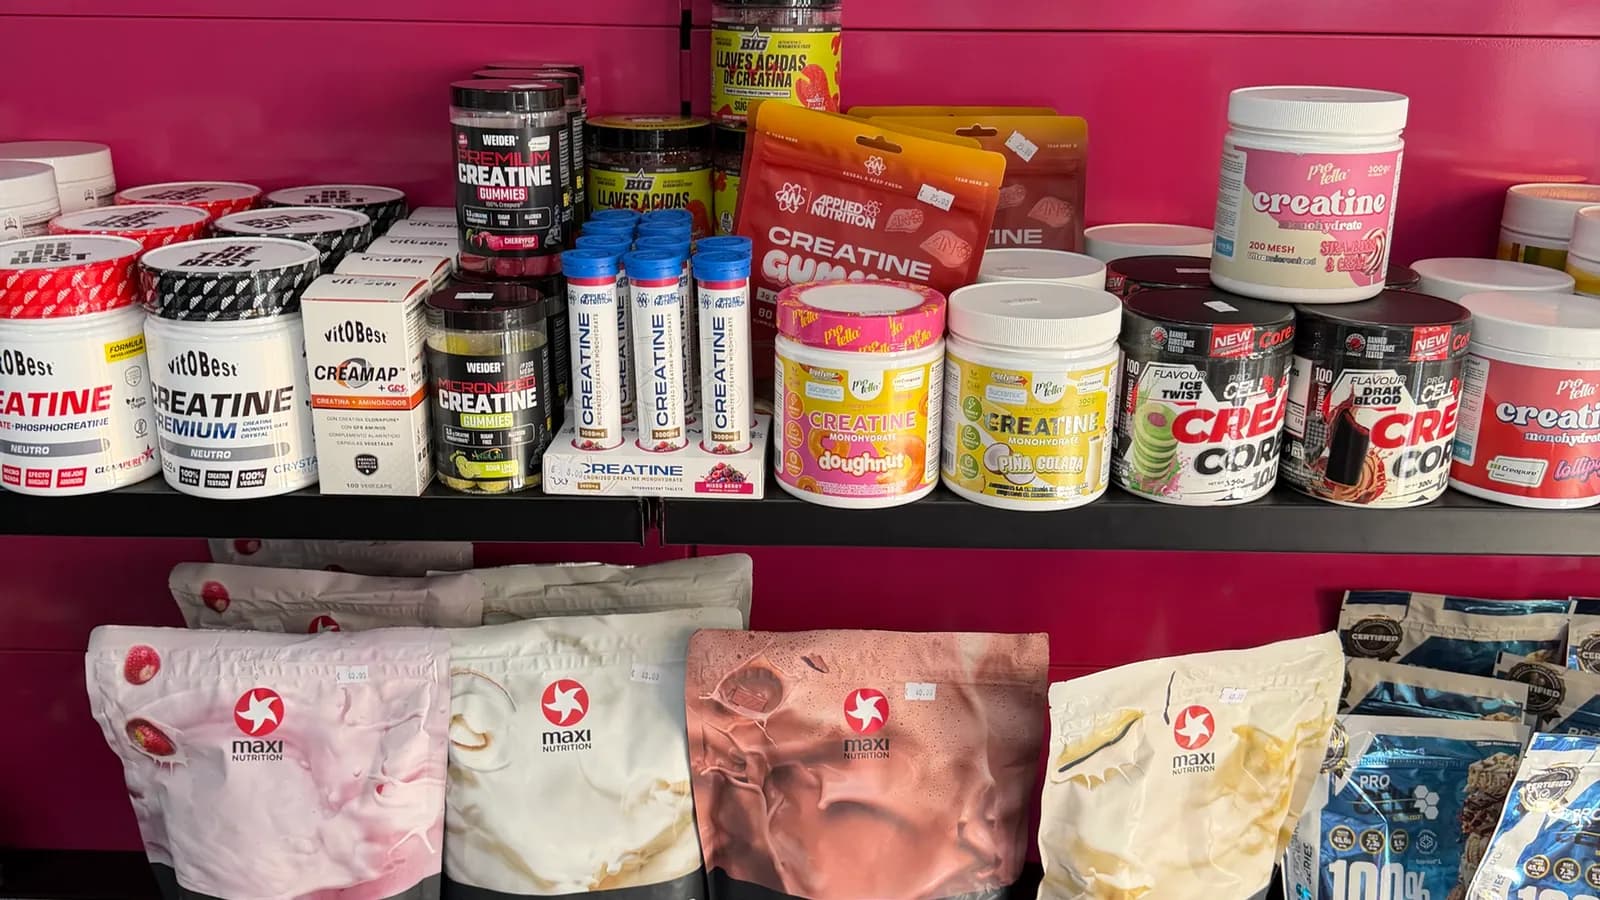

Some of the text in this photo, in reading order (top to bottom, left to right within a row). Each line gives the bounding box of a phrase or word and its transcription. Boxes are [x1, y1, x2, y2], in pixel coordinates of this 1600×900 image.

[740, 38, 768, 50] BIG
[716, 51, 753, 70] LLAVES
[724, 71, 792, 88] DE CREATINA
[482, 134, 516, 146] WEIDER
[458, 150, 550, 166] PREMIUM
[458, 164, 552, 187] CREATINE
[624, 180, 654, 191] BIG
[479, 188, 526, 202] GUMMIES
[598, 189, 639, 209] LLAVES
[1253, 188, 1387, 216] creatine
[813, 194, 863, 216] APPLIED
[811, 206, 876, 229] NUTRITION
[990, 228, 1042, 244] INE
[768, 226, 933, 281] CREATINE
[1249, 241, 1295, 254] 200 MESH
[758, 307, 773, 320] 80
[324, 320, 387, 343] vitOBest
[1214, 329, 1251, 348] NEW
[1366, 344, 1395, 353] SUBSTANCE
[1414, 332, 1448, 351] NEW
[168, 350, 237, 377] vitOBest
[466, 362, 501, 374] WEIDER
[578, 312, 594, 425] CREATINE
[652, 314, 668, 426] CREATINE
[1126, 358, 1140, 375] 100
[314, 365, 398, 382] CREAMAP
[713, 316, 727, 429] CREATINE
[1153, 369, 1206, 381] FLAVOUR
[1315, 367, 1332, 383] 100
[1350, 375, 1407, 385] FLAVOUR
[438, 376, 536, 394] MICRONIZED
[1180, 381, 1203, 391] ICE
[1426, 376, 1444, 386] PRO
[1162, 390, 1203, 400] TWIST
[1363, 386, 1402, 396] DRAK
[151, 381, 294, 418] CREATINE
[316, 397, 351, 406] CREATINA
[438, 387, 538, 413] CREATINE
[1354, 395, 1402, 406] BLOOD
[15, 417, 109, 432] PHOSPHOCREATINE
[463, 414, 512, 428] GUMMIES
[809, 411, 916, 433] CREATINE
[986, 412, 1099, 437] CREATINE
[830, 432, 896, 442] MONOHYDRATE
[1008, 436, 1081, 447] MONOHYDRATE
[10, 444, 50, 455] NEUTRO
[190, 448, 232, 460] NEUTRO
[819, 451, 906, 476] doughnut
[1037, 456, 1084, 473] COLADA
[1502, 465, 1537, 476] Creapure
[180, 467, 199, 478] 100%
[240, 469, 265, 480] 100%
[1351, 632, 1398, 643] CERTIFIED
[543, 729, 591, 745] maxi
[232, 740, 283, 753] maxi
[543, 743, 592, 753] NUTRITION
[844, 738, 890, 752] maxi
[843, 751, 890, 760] NUTRITION
[1172, 752, 1215, 769] maxi
[1172, 766, 1216, 776] NUTRITION
[1360, 774, 1391, 789] PRO
[1526, 780, 1572, 792] CERTIFIED
[1329, 859, 1431, 900] 100%
